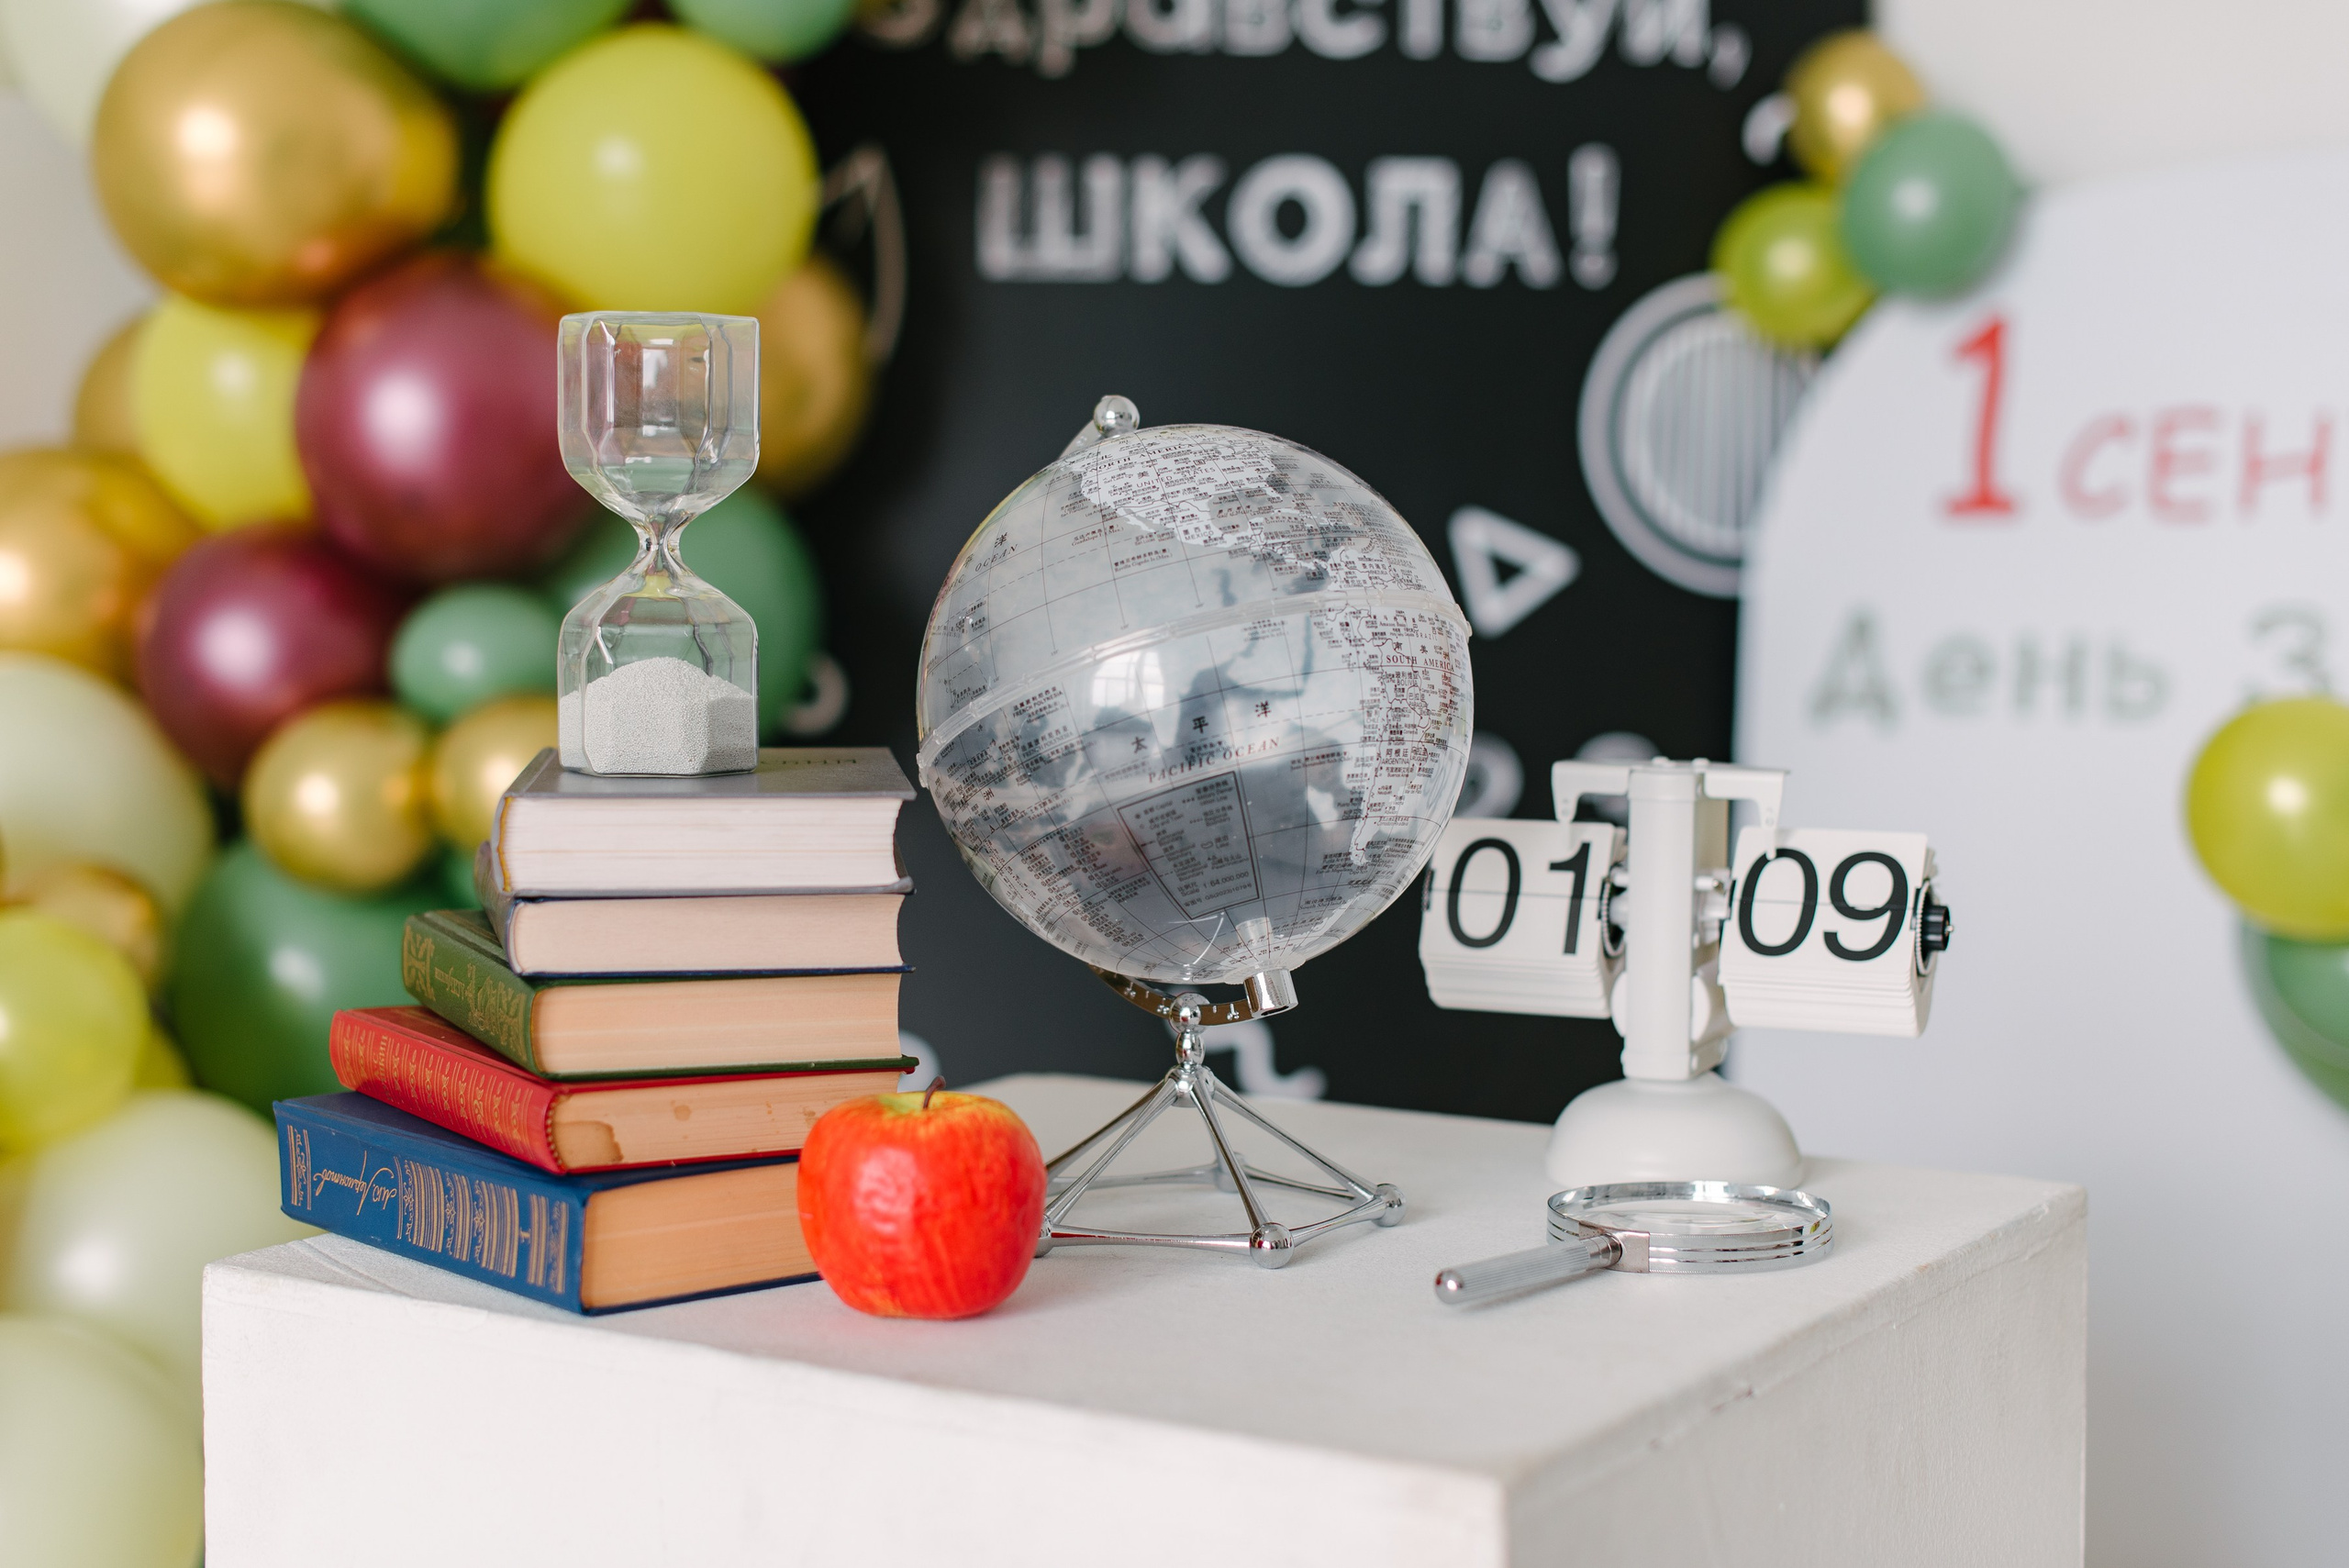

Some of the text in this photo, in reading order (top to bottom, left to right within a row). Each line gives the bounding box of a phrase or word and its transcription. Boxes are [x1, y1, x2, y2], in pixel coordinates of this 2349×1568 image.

[975, 145, 1620, 287] ШКОЛА!
[1947, 312, 2019, 518] 1
[1090, 444, 1194, 472] NORTH AMERICA
[1136, 475, 1173, 488] UNITED
[1181, 467, 1216, 478] STATES
[1185, 530, 1214, 541] MEXICO
[974, 544, 1018, 573] OCEAN
[1416, 632, 1438, 640] BRAZIL
[1386, 655, 1454, 672] SOUTH AMERICA
[1805, 604, 2174, 734] День
[1013, 691, 1063, 718] FRENCH POLYNESIA
[1022, 746, 1042, 760] FRENCH
[1043, 731, 1074, 750] POLYNESIA
[1386, 748, 1408, 758] 阿根廷
[1148, 755, 1216, 784] PACIFIC
[1223, 737, 1280, 760] OCEAN
[1181, 888, 1200, 896] Scale
[1447, 838, 1591, 956] 01
[1739, 848, 1909, 962] 09
